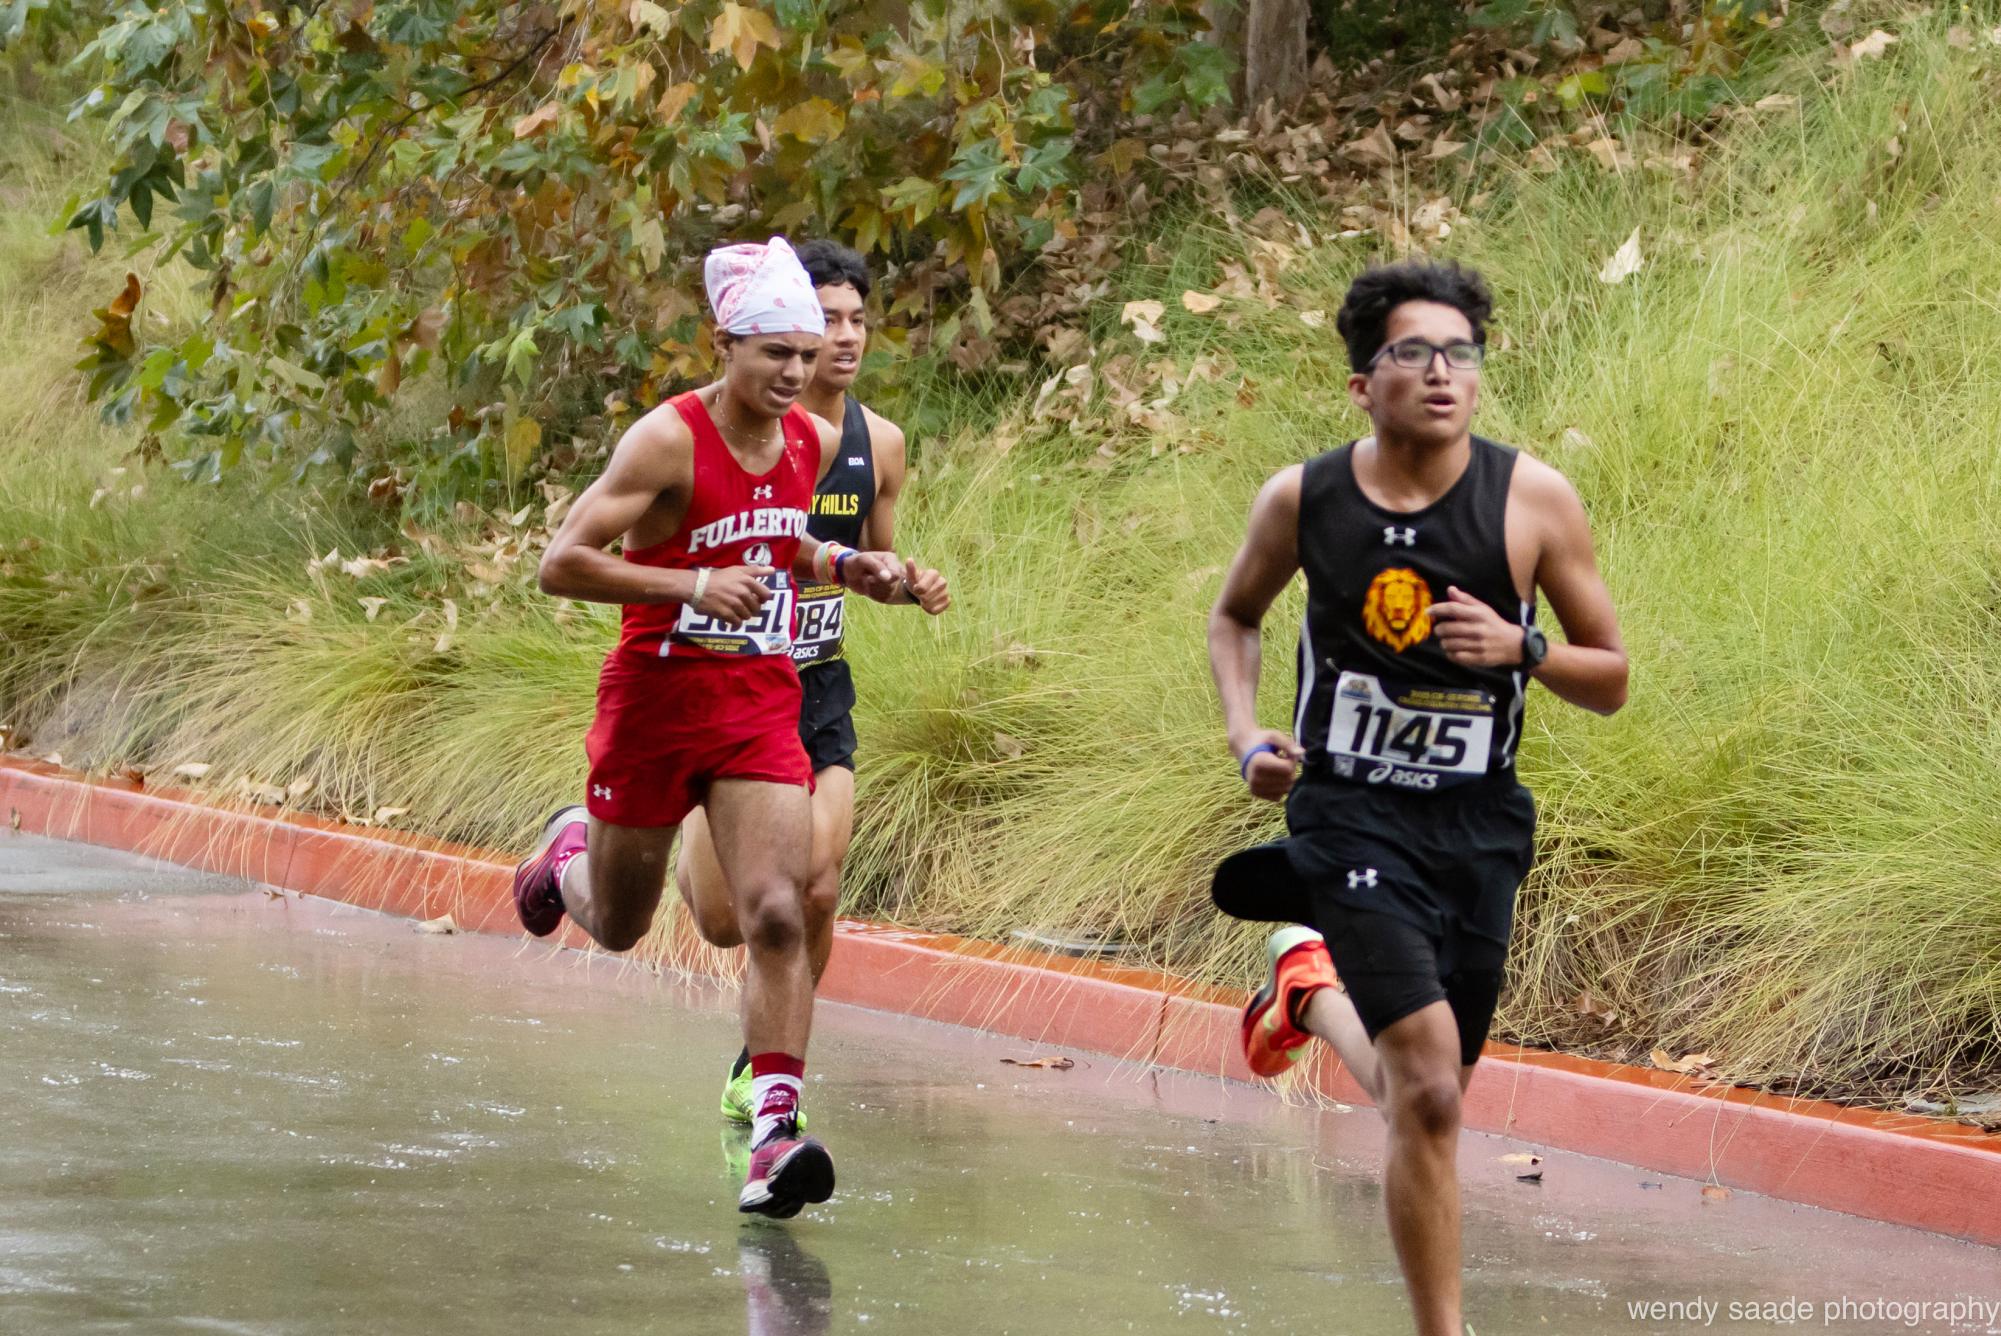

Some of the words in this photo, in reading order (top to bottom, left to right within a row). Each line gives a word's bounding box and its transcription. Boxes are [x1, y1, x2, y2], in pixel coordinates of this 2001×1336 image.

[808, 494, 821, 515] Y
[821, 494, 859, 516] HILLS
[687, 507, 808, 554] FULLERTO
[793, 645, 819, 659] asics
[1350, 703, 1473, 767] 1145
[1390, 769, 1438, 790] asics
